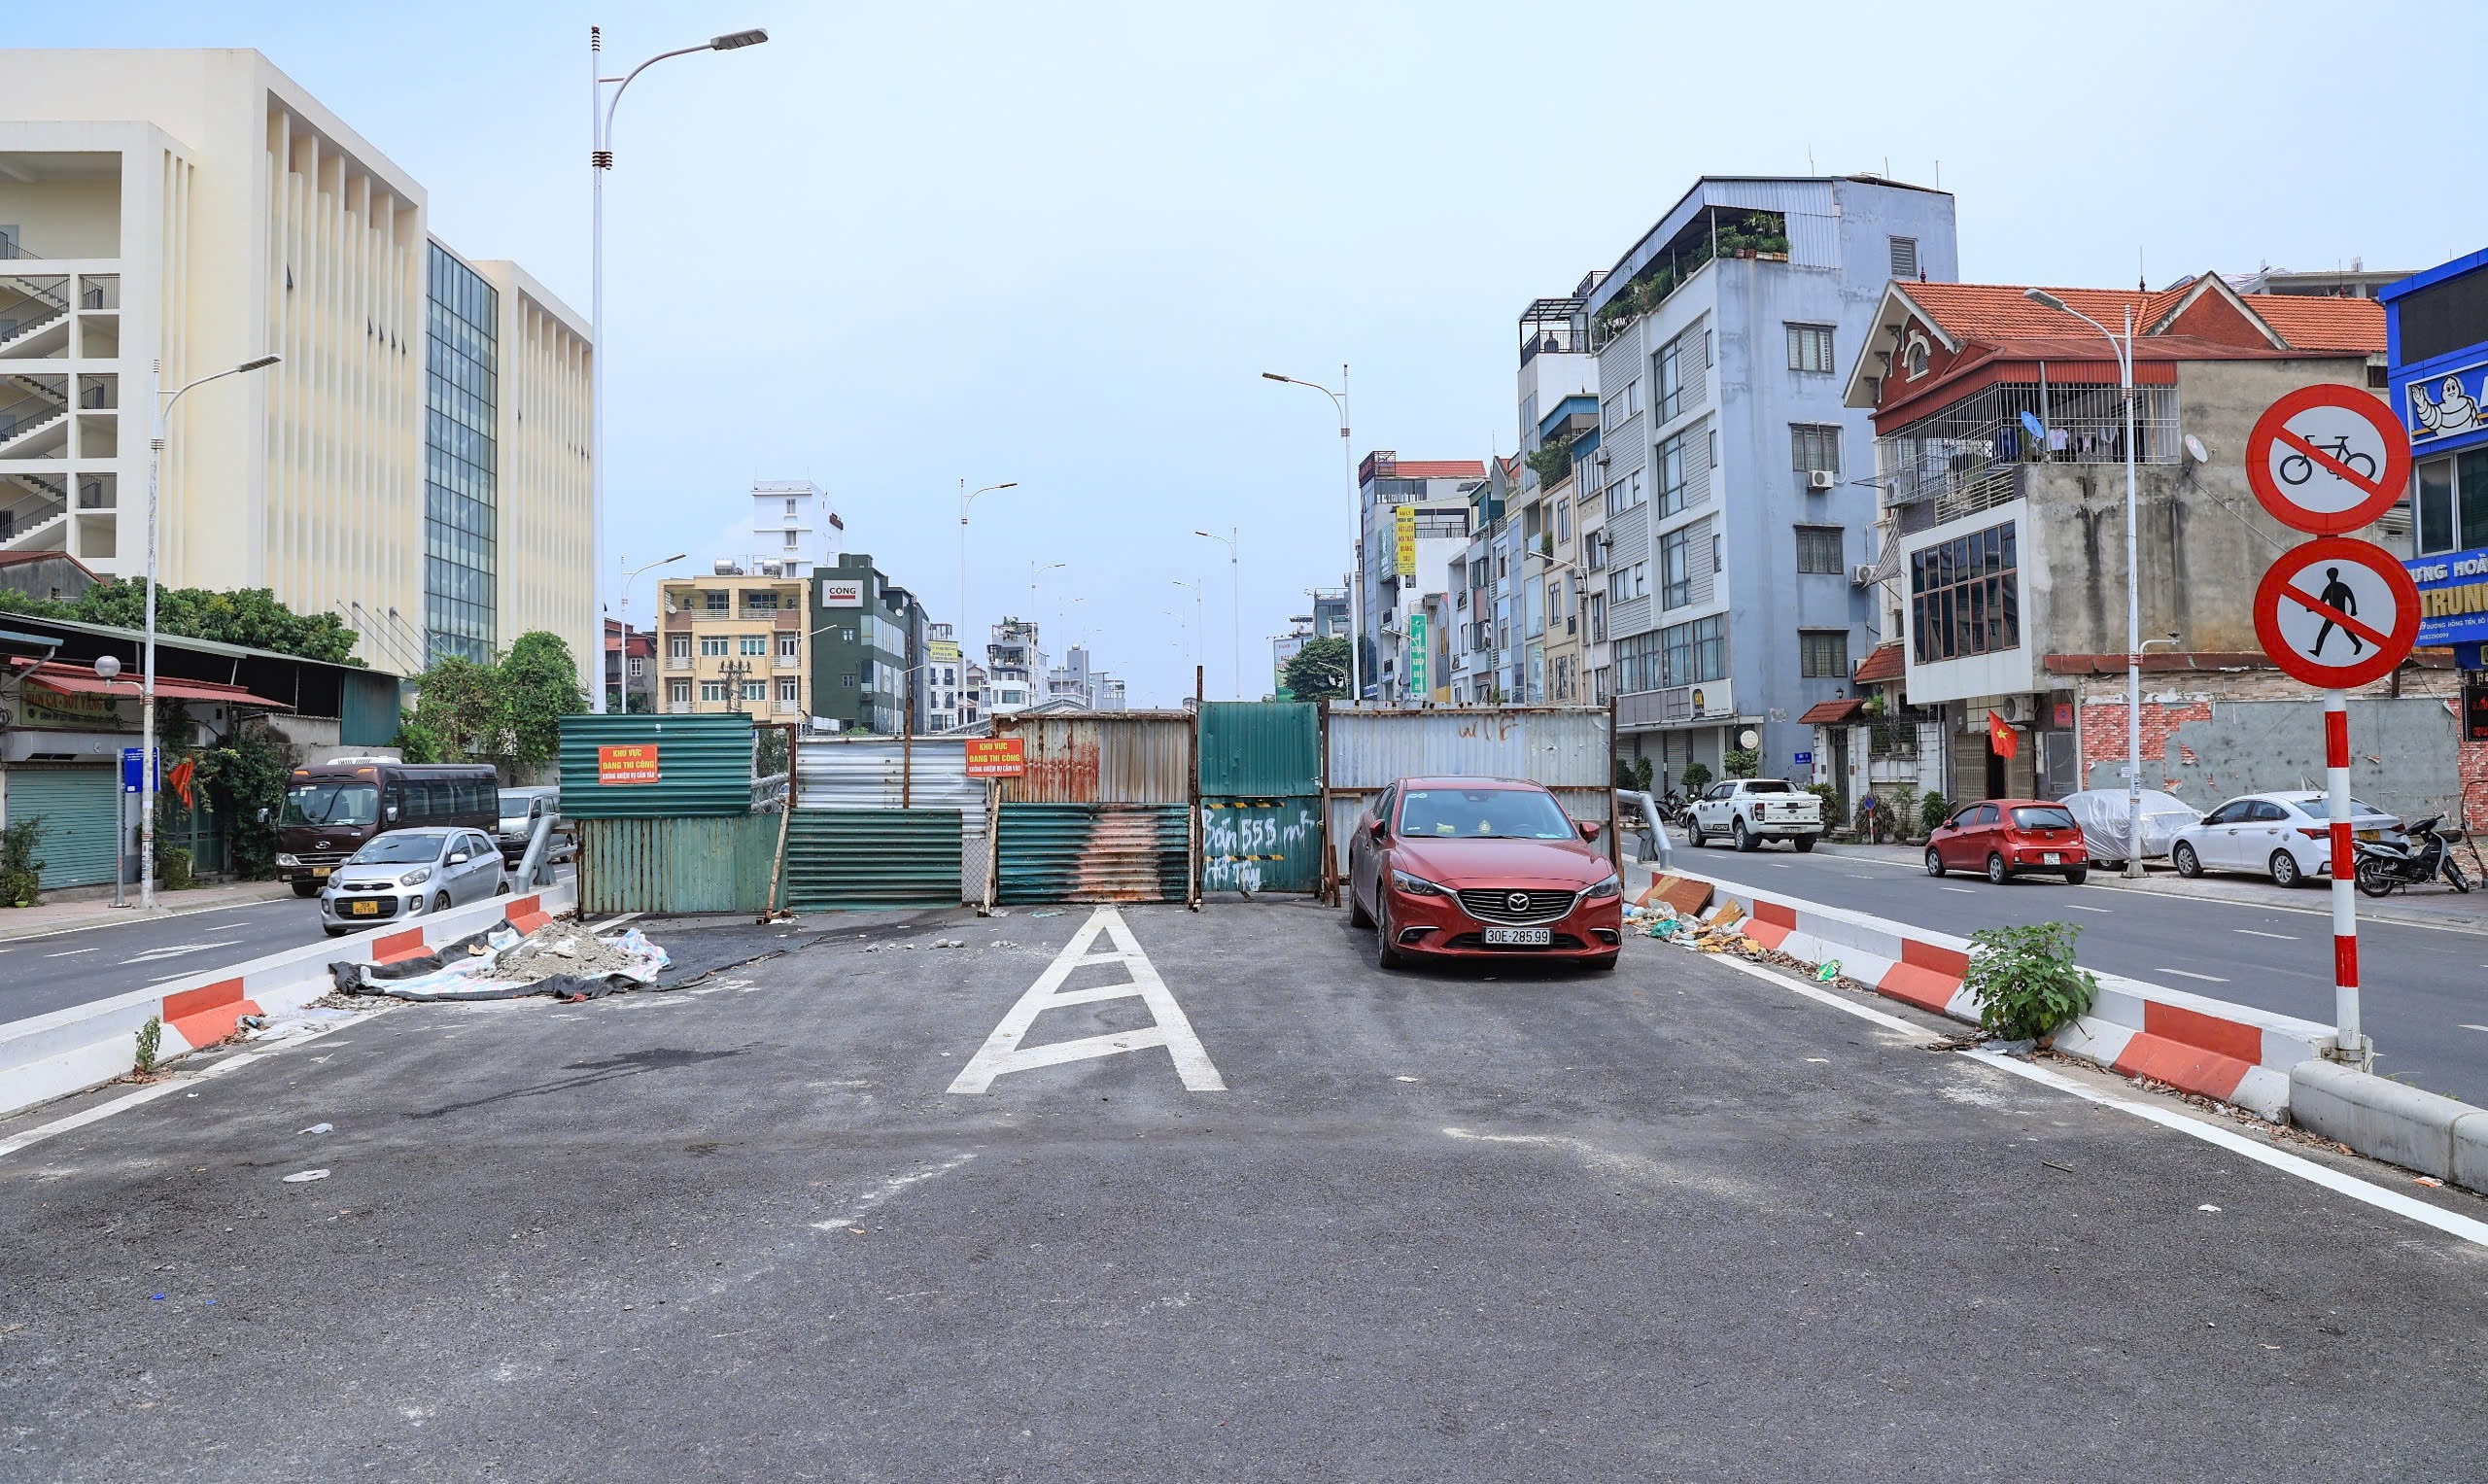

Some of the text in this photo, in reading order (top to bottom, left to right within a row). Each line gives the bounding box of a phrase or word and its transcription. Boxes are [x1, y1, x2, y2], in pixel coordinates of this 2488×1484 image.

[979, 742, 1008, 751] KHU VỰC
[612, 747, 641, 758] KHU VỰC
[969, 754, 987, 763] ĐANG
[1001, 752, 1020, 762] CÔNG
[603, 761, 621, 770] ĐANG
[636, 759, 654, 769] CÔNG
[1487, 929, 1548, 943] 30E-285.99
